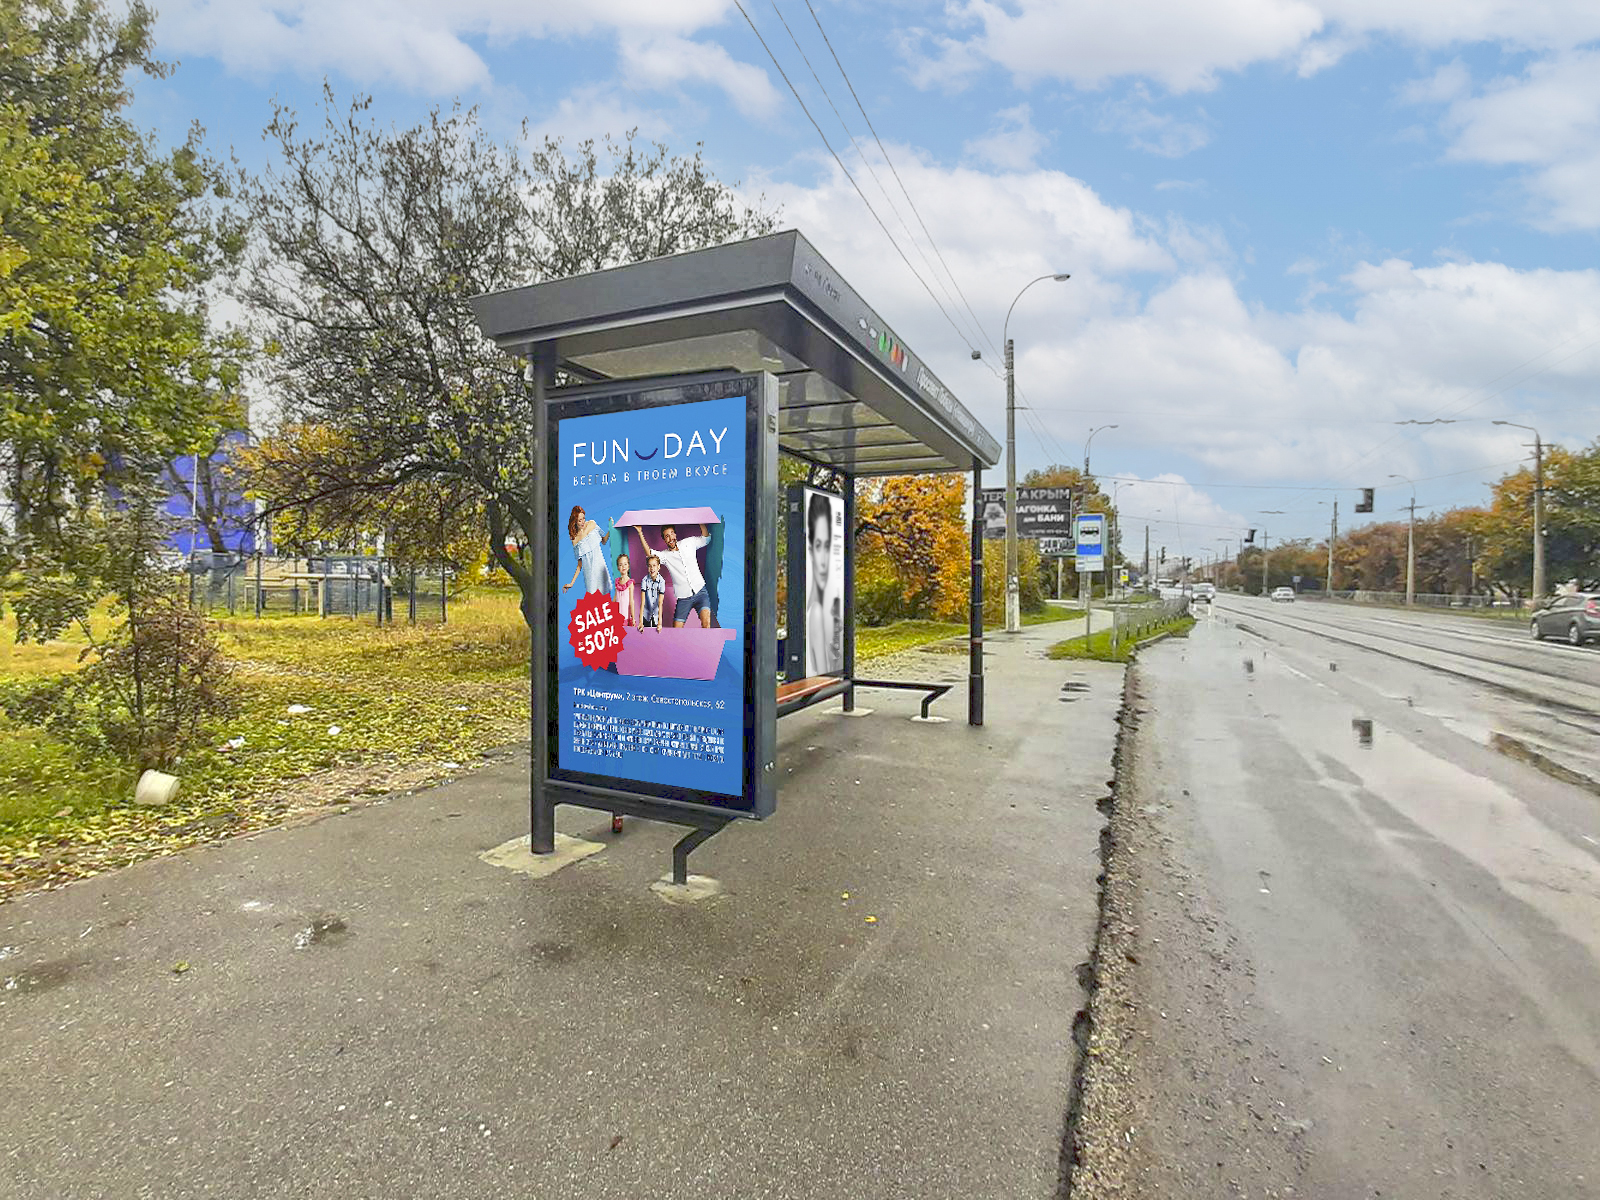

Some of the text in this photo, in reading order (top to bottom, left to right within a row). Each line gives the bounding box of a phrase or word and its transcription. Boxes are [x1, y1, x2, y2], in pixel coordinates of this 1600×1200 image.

[573, 427, 728, 467] FUN DAY
[573, 463, 728, 487] ВСЕГДА В ТВОЕМ ВКУСЕ
[1037, 514, 1064, 522] БАНИ
[575, 601, 613, 633] SALE
[573, 687, 586, 697] ТРК
[626, 692, 631, 701] 2
